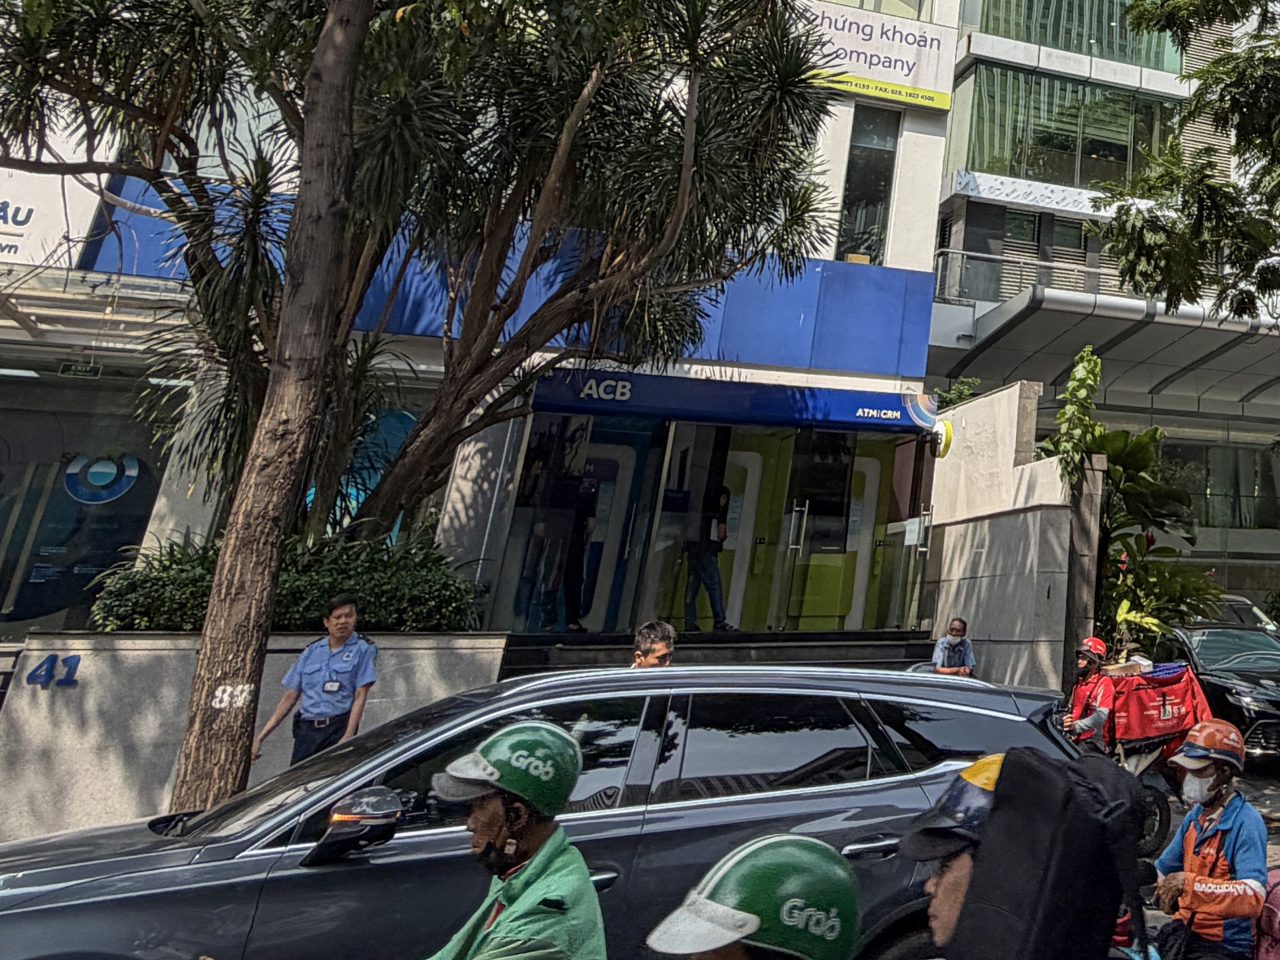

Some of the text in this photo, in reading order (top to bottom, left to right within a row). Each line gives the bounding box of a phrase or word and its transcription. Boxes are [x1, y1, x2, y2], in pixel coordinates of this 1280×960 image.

[880, 23, 941, 50] khoán
[820, 37, 916, 76] Company
[580, 379, 632, 401] ACB
[856, 408, 901, 419] ATM CRM
[26, 654, 81, 690] 41
[511, 750, 555, 781] Grab
[780, 898, 840, 940] Grab
